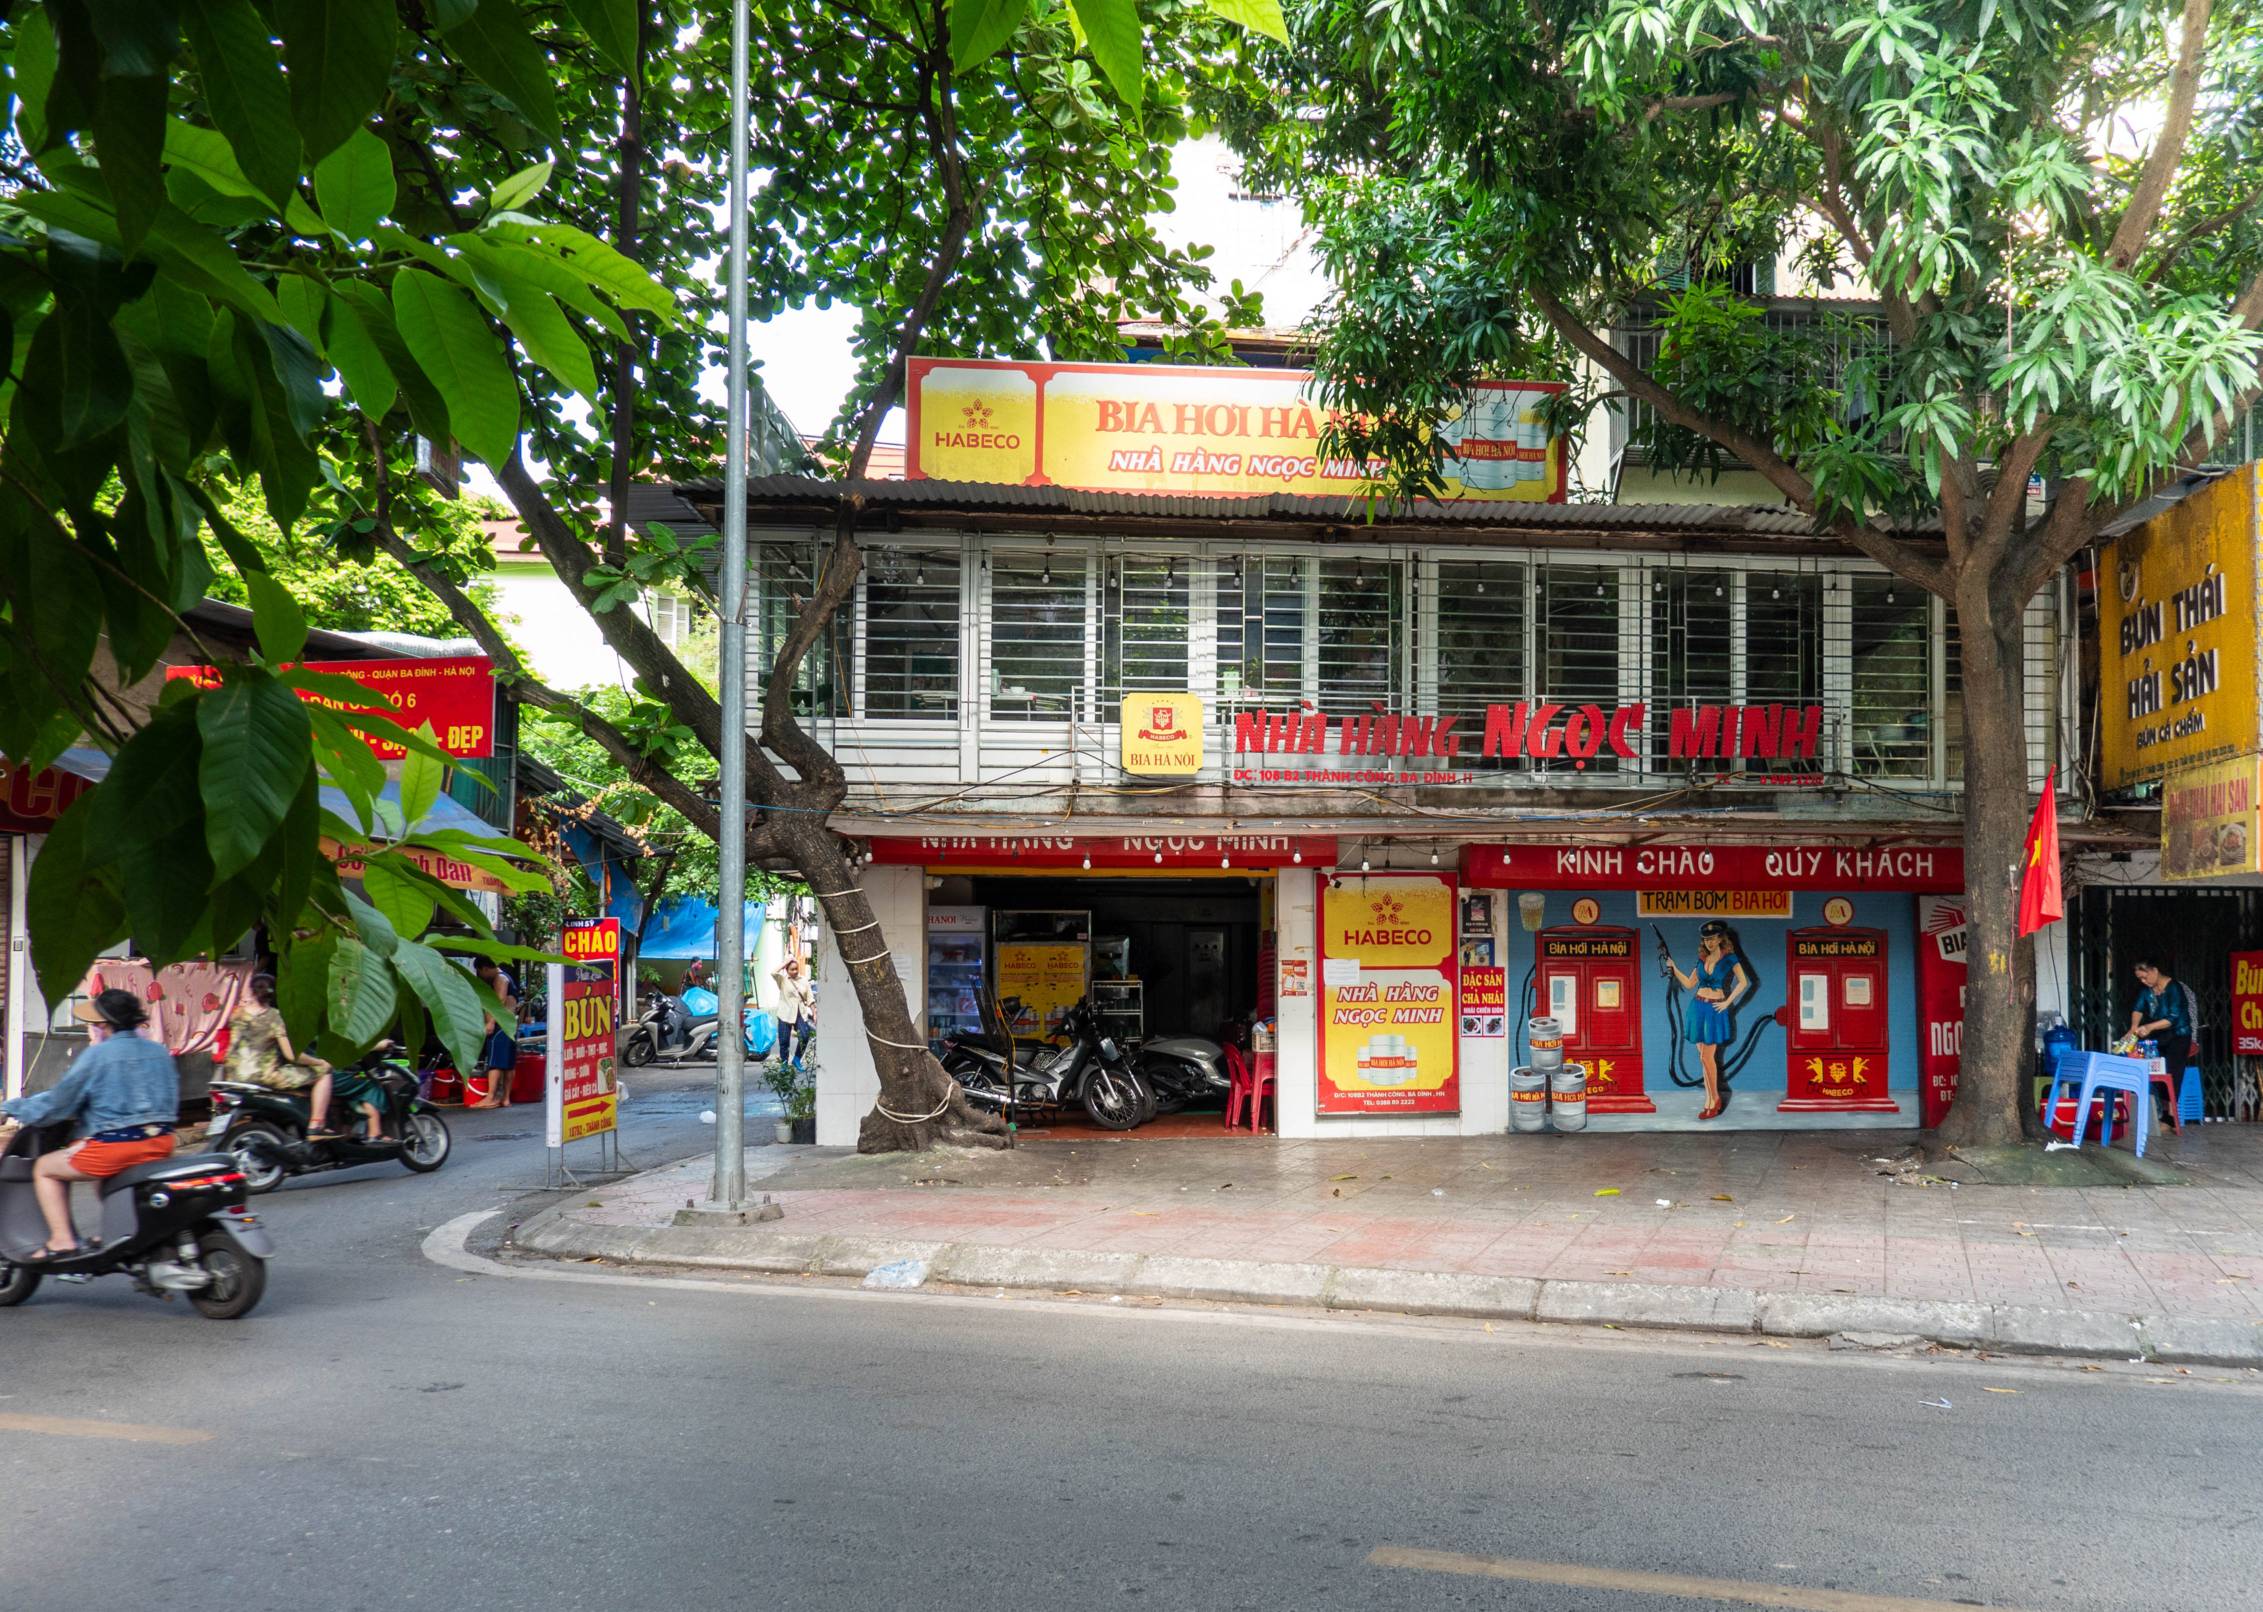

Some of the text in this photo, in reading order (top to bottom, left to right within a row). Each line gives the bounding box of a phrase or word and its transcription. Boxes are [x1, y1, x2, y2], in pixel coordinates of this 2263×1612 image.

[1095, 399, 1167, 433] BIA
[1173, 403, 1251, 436] HƠI
[1260, 399, 1320, 439] HÀ
[935, 432, 1020, 449] HABECO
[1108, 445, 1164, 473] NHÀ
[1169, 446, 1240, 475] HÀNG
[1245, 453, 1317, 482] NGỌC
[2121, 562, 2226, 656] BÚN THÁI
[400, 669, 413, 678] BA
[444, 665, 458, 676] HÀ
[459, 665, 475, 677] NỘI
[2128, 640, 2219, 720] HẢI SẢN
[407, 693, 417, 708] 6
[448, 725, 484, 754] ĐẸP
[1235, 700, 1823, 770] NHÀ HÀNG NGỌC MINH
[1130, 751, 1195, 767] BIA HÀ NỘI
[1304, 769, 1351, 783] THÀNH
[1557, 845, 1622, 875] KÍNH
[1637, 846, 1714, 875] CHÀO
[1836, 848, 1933, 878] KHÁCH
[1643, 891, 1690, 913] TRẠM
[564, 926, 617, 953] CHÁO
[1344, 929, 1432, 945] HABECO
[1941, 931, 1967, 955] BIA
[1462, 969, 1503, 990] ĐẶC SẢN
[1337, 980, 1440, 1003] NHÀ HÀNG
[1462, 987, 1480, 1004] CHẢ
[564, 985, 612, 1041] BÚN
[1333, 1007, 1444, 1029] NGỌC MINH
